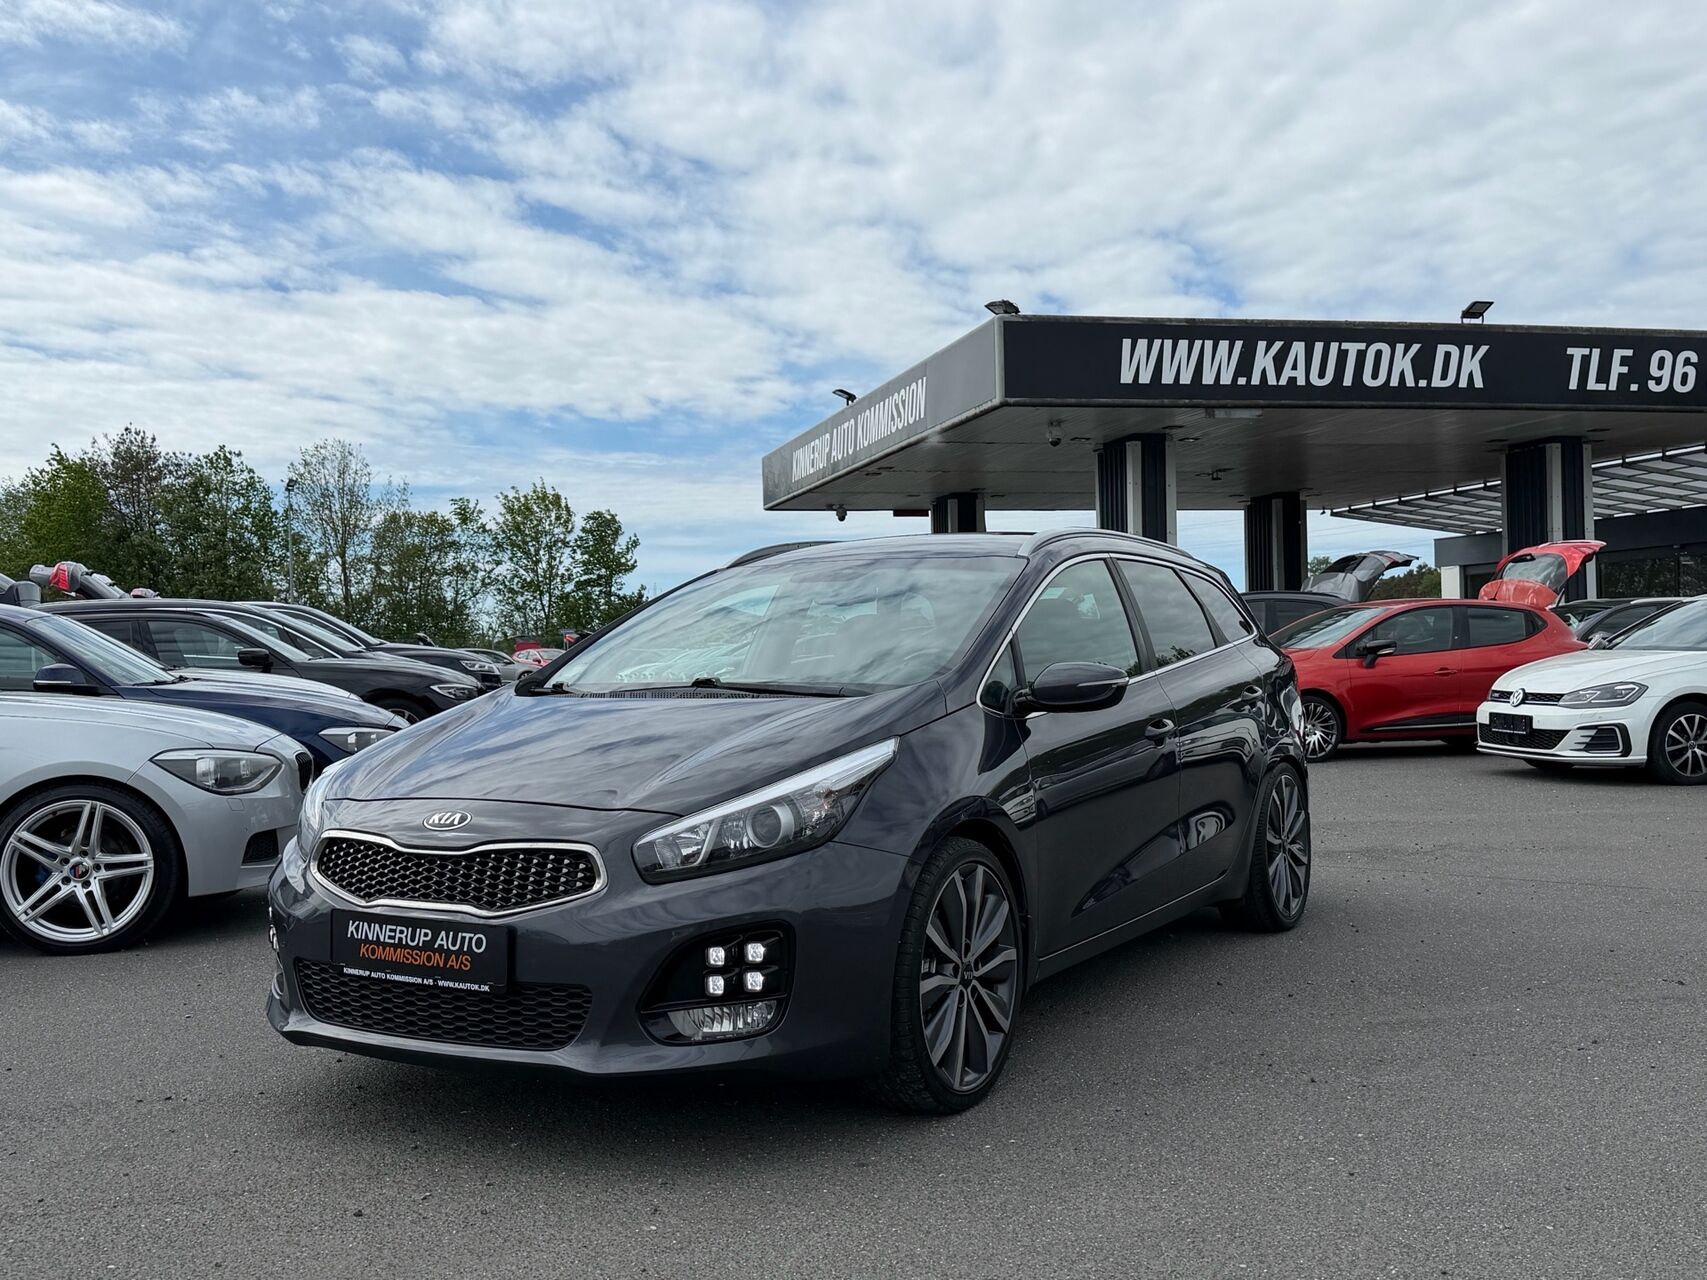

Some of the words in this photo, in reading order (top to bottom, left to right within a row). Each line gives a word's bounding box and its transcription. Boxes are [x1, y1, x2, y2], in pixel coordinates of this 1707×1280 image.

[1119, 338, 1490, 388] WWW.KAUTOK.DK
[1566, 347, 1639, 391] TLF.
[1647, 349, 1699, 393] 96
[792, 432, 831, 483] KINNERUP
[831, 418, 855, 463] AUTO
[857, 376, 927, 451] KOMMISSION
[428, 812, 462, 825] KIA
[347, 920, 432, 947] KINNERUP
[434, 930, 487, 953] AUTO
[359, 943, 445, 968] KOMMISSION
[446, 953, 471, 971] A/S
[343, 967, 370, 977] KINNERUP
[370, 971, 386, 980] AUTO
[386, 973, 423, 985] KOMMISSION
[423, 977, 434, 986] A/S
[437, 979, 491, 992] WWW.KAUTOK.DK
